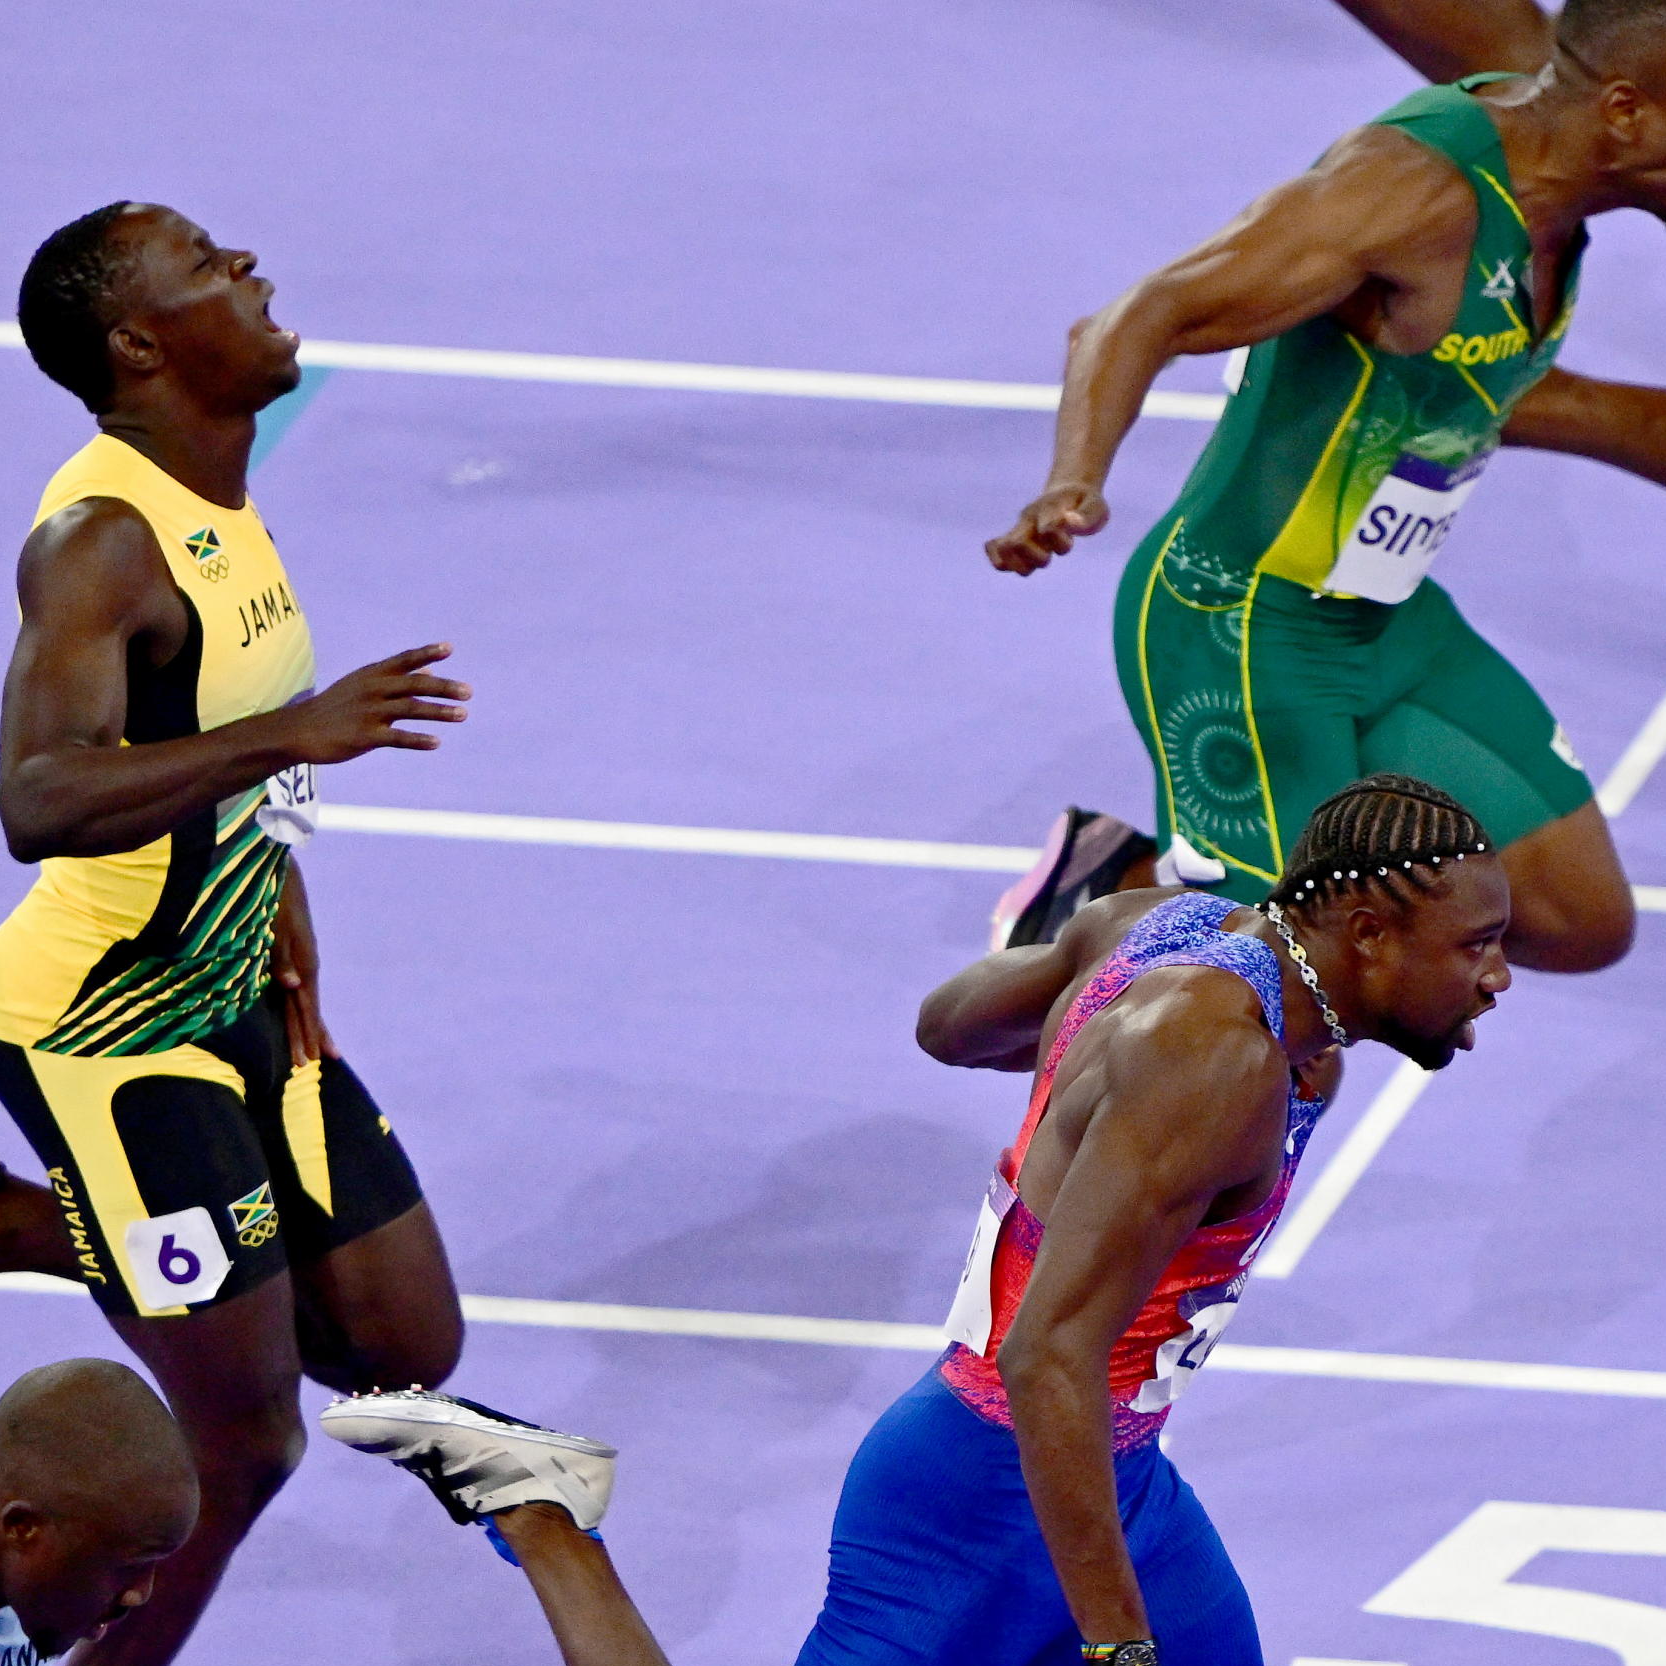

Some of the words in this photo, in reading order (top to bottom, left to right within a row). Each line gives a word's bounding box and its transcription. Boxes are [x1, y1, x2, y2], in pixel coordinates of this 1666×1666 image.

[238, 581, 300, 648] JAMA
[48, 1166, 107, 1285] JAMAICA
[158, 1234, 201, 1285] 6
